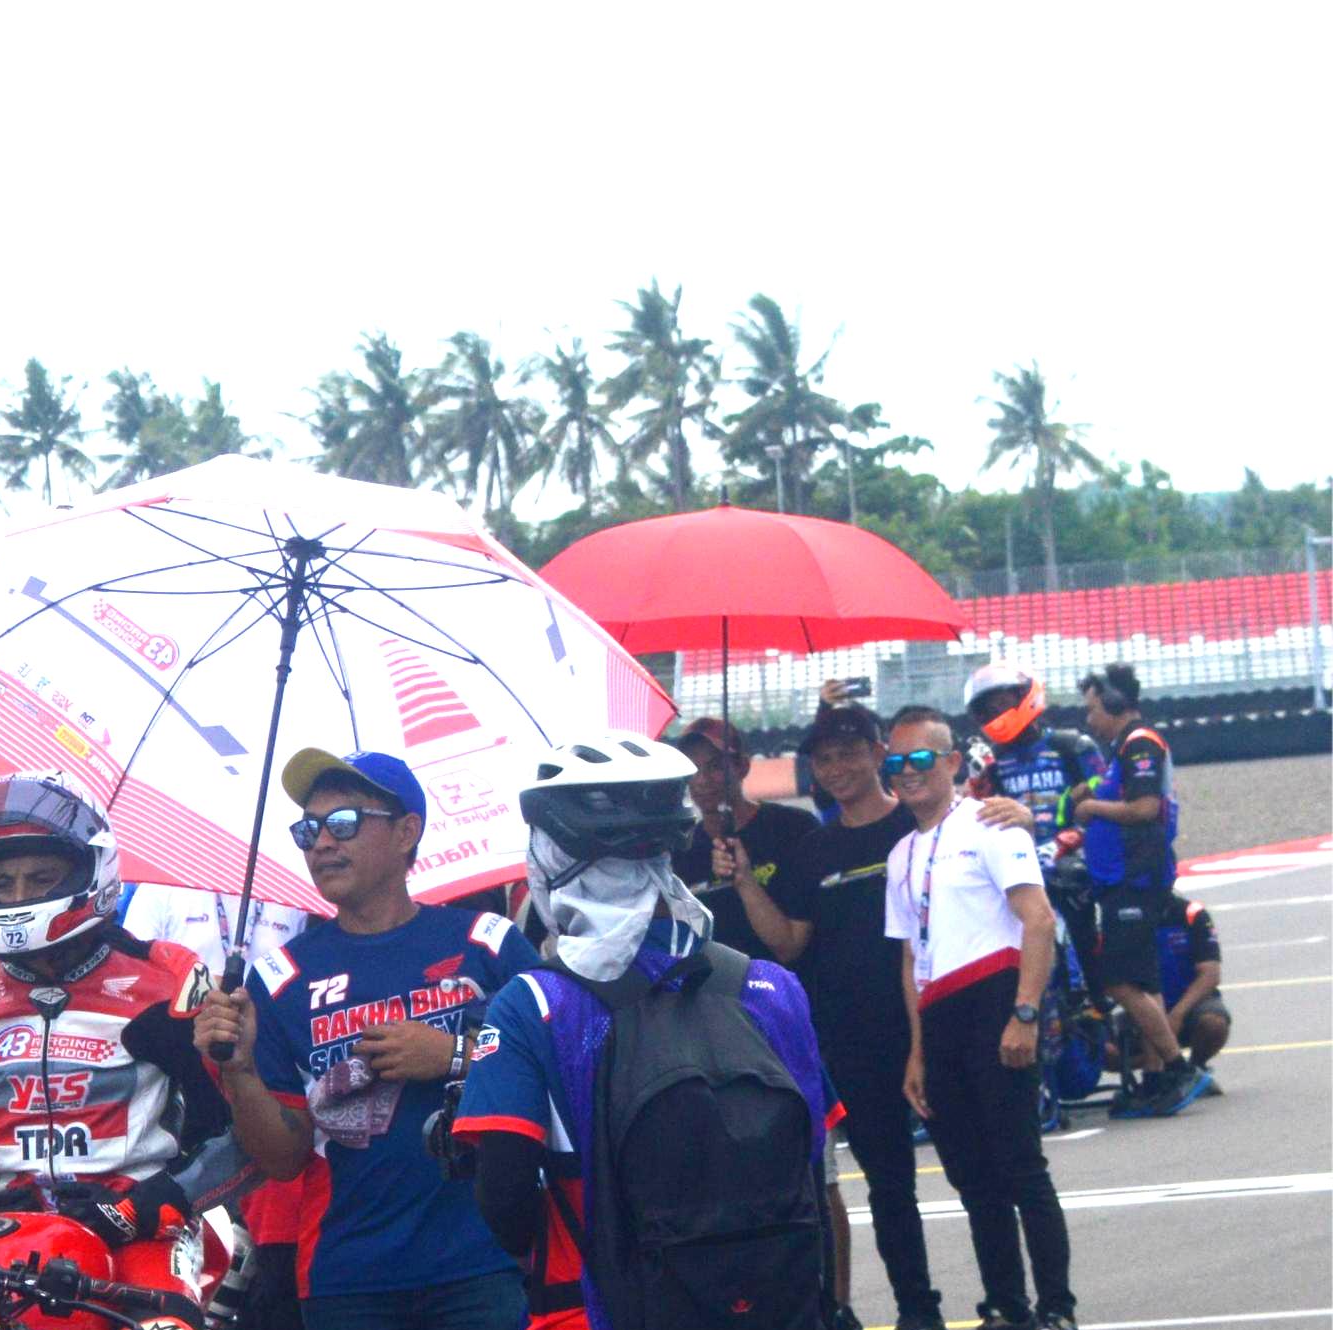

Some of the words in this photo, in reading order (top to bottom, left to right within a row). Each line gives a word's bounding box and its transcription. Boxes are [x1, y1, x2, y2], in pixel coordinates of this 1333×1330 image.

[5, 932, 24, 945] 72
[309, 974, 350, 1010] 72
[310, 995, 406, 1048] RAKHA
